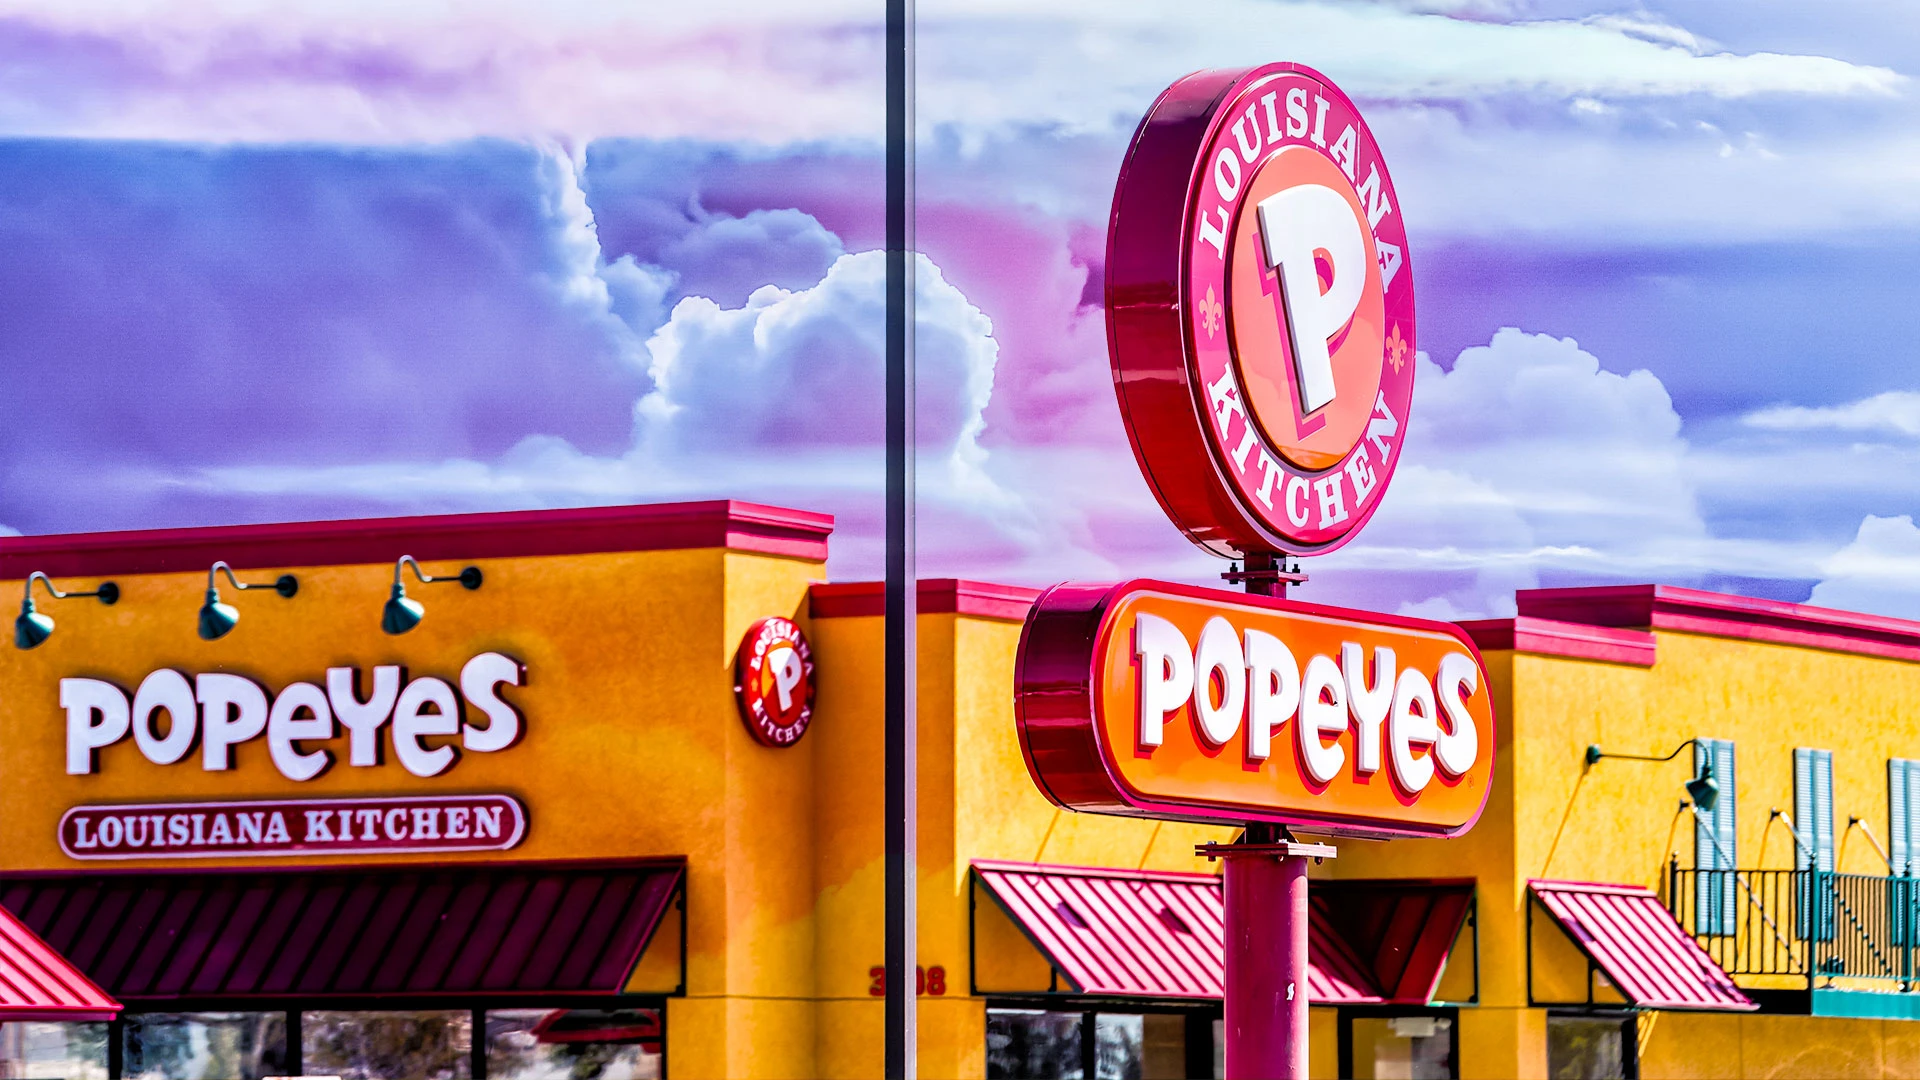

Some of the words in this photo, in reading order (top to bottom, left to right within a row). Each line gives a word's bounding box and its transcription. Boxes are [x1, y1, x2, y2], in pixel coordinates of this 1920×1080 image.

[1198, 87, 1403, 294] LOUISIANA
[1257, 183, 1366, 416] P
[1207, 361, 1399, 530] KITCHEN
[73, 811, 291, 848] LOUISIANA
[303, 806, 503, 842] KITCHEN
